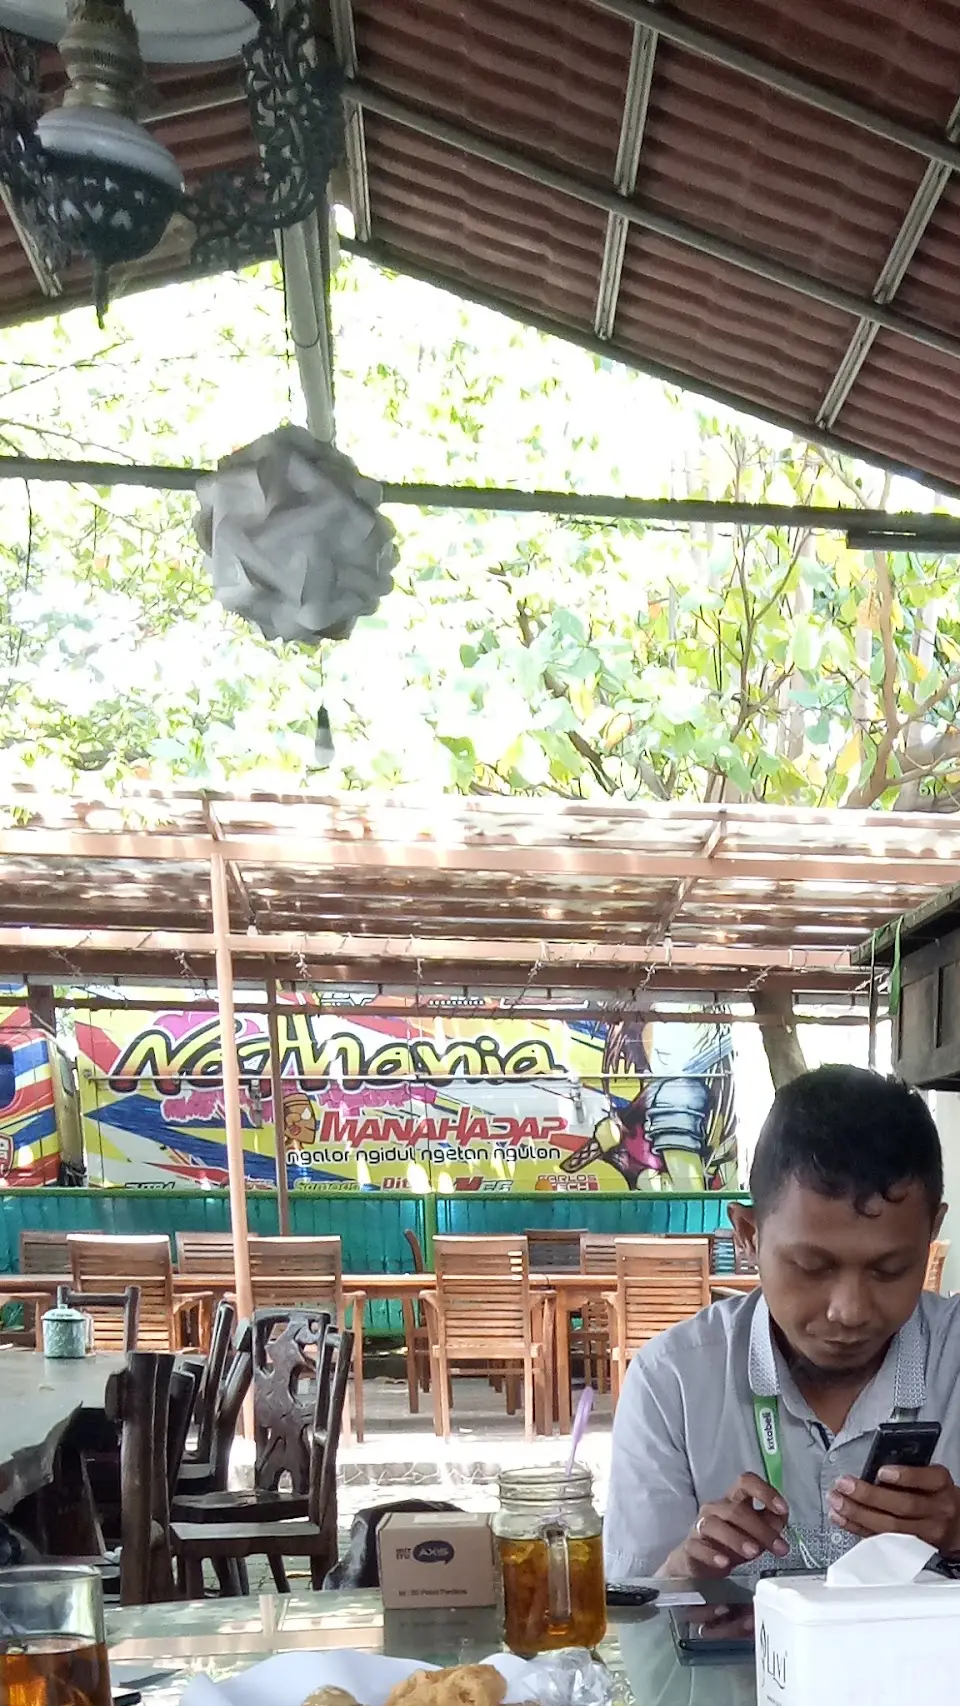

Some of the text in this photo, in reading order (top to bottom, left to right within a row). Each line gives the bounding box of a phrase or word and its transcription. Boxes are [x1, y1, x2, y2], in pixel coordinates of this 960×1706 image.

[287, 1145, 560, 1167] ngalor ngidul ngetan ngulon
